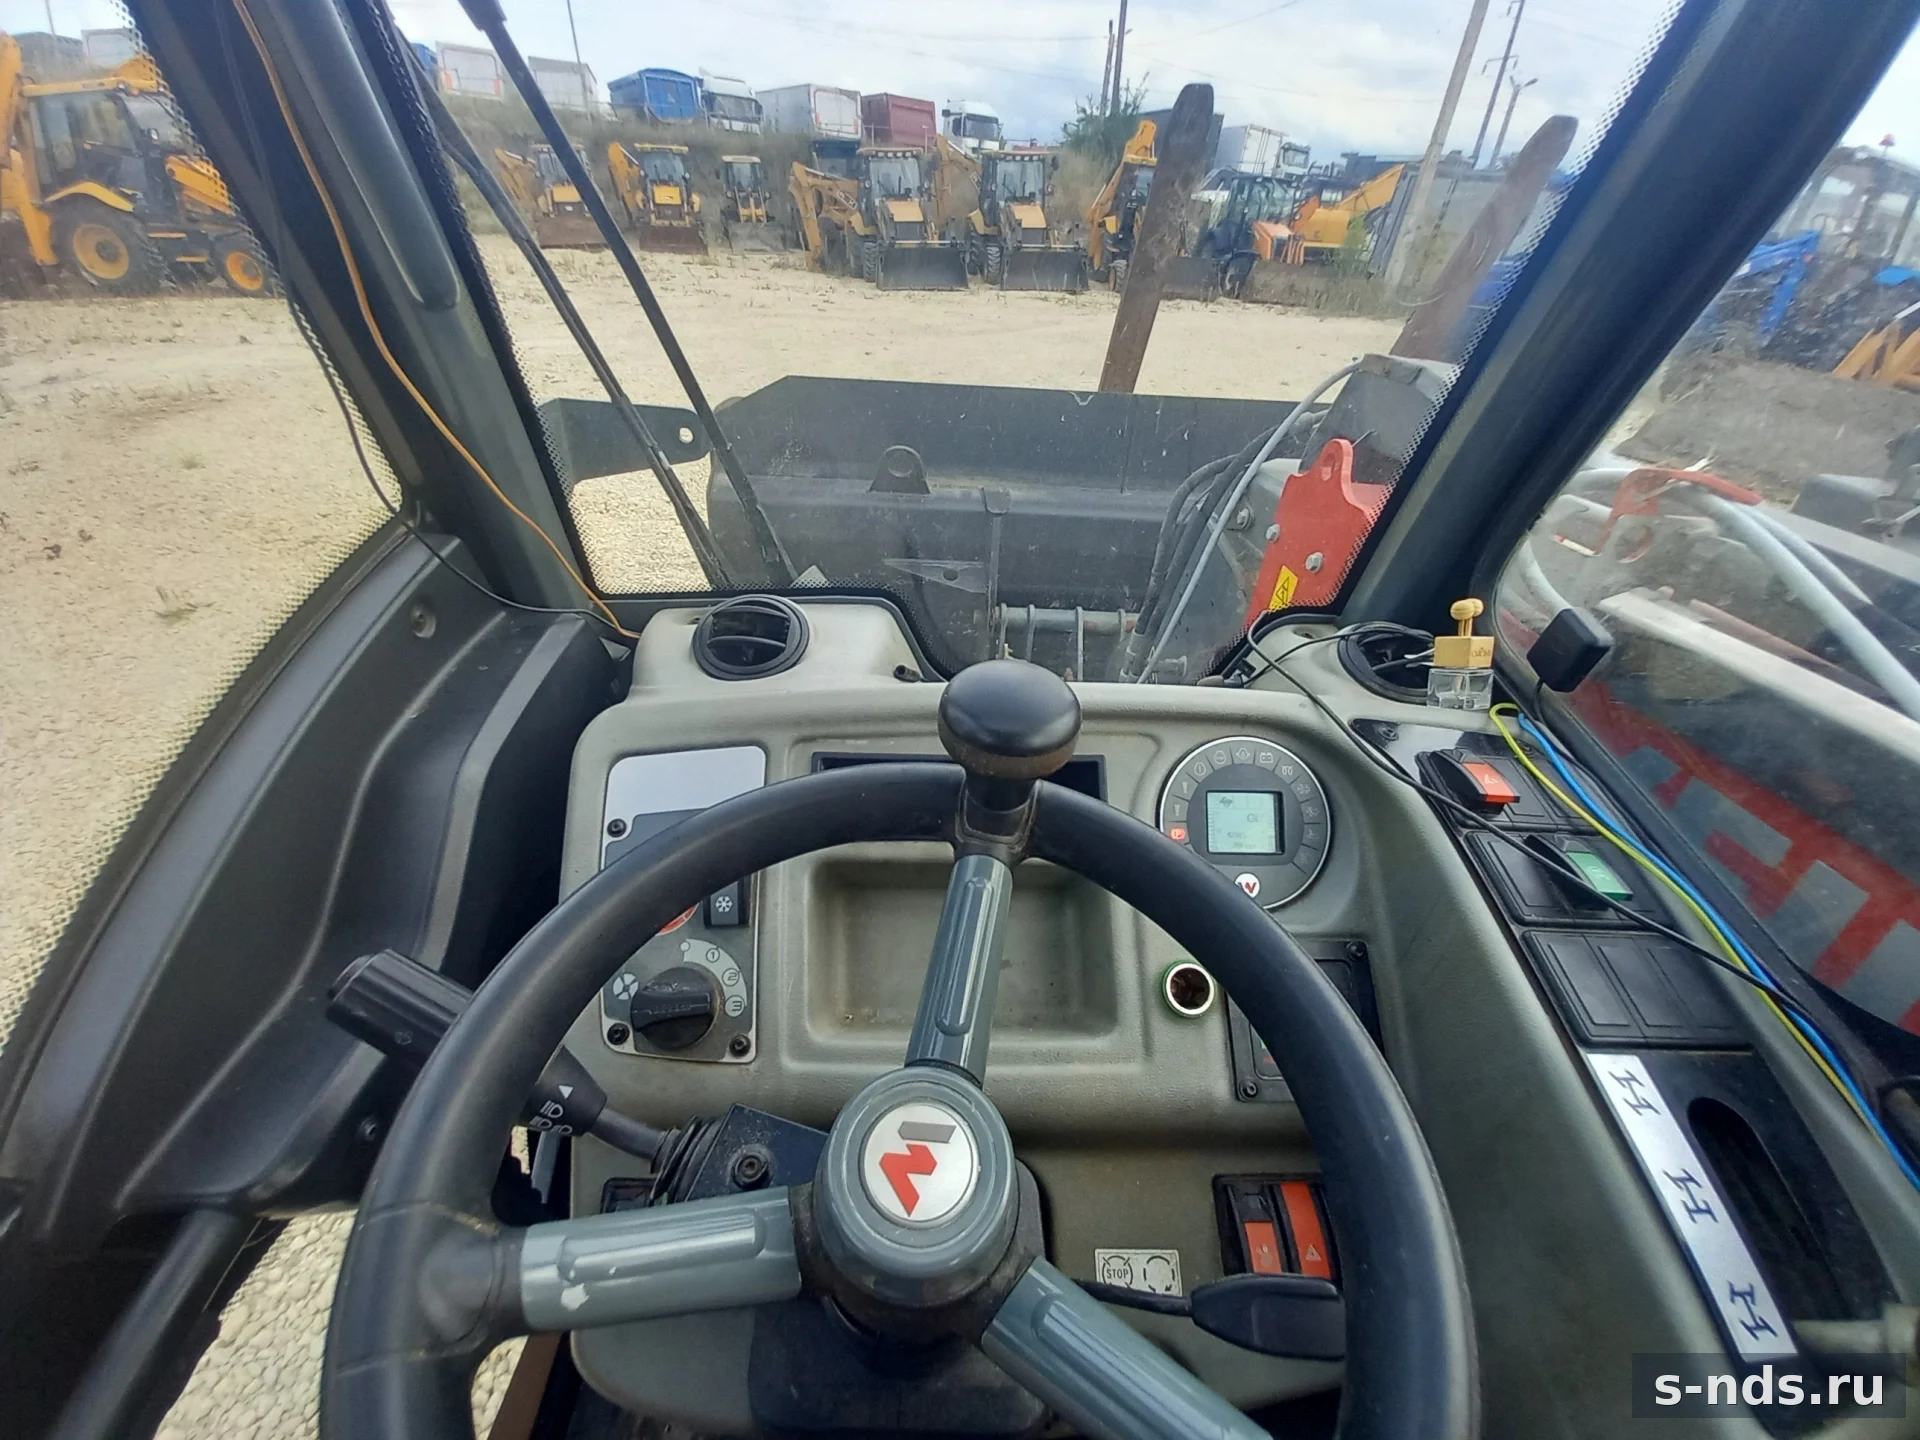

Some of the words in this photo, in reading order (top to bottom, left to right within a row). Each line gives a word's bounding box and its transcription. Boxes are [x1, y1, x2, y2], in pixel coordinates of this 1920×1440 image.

[728, 973, 738, 981] 2
[731, 1001, 742, 1012] 3
[1106, 1268, 1129, 1279] STOP
